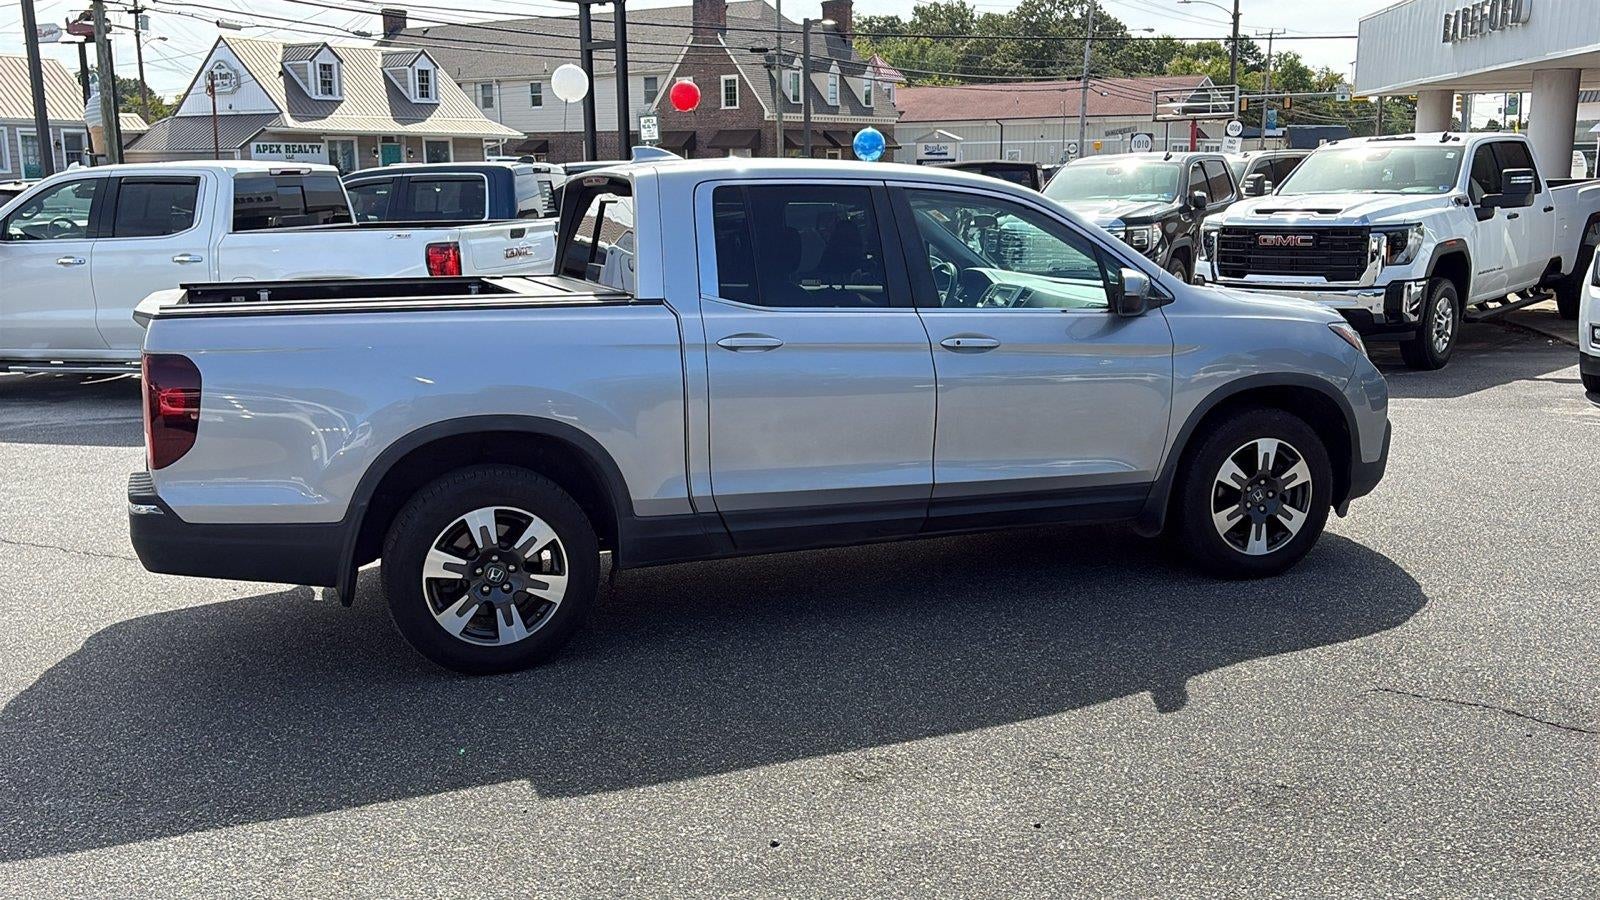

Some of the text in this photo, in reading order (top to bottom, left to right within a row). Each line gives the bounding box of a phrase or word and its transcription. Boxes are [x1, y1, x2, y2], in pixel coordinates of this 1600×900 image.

[255, 143, 322, 155] APEX REALTY
[1133, 140, 1149, 149] 1010
[1258, 234, 1314, 247] GMC
[503, 245, 534, 260] GMC
